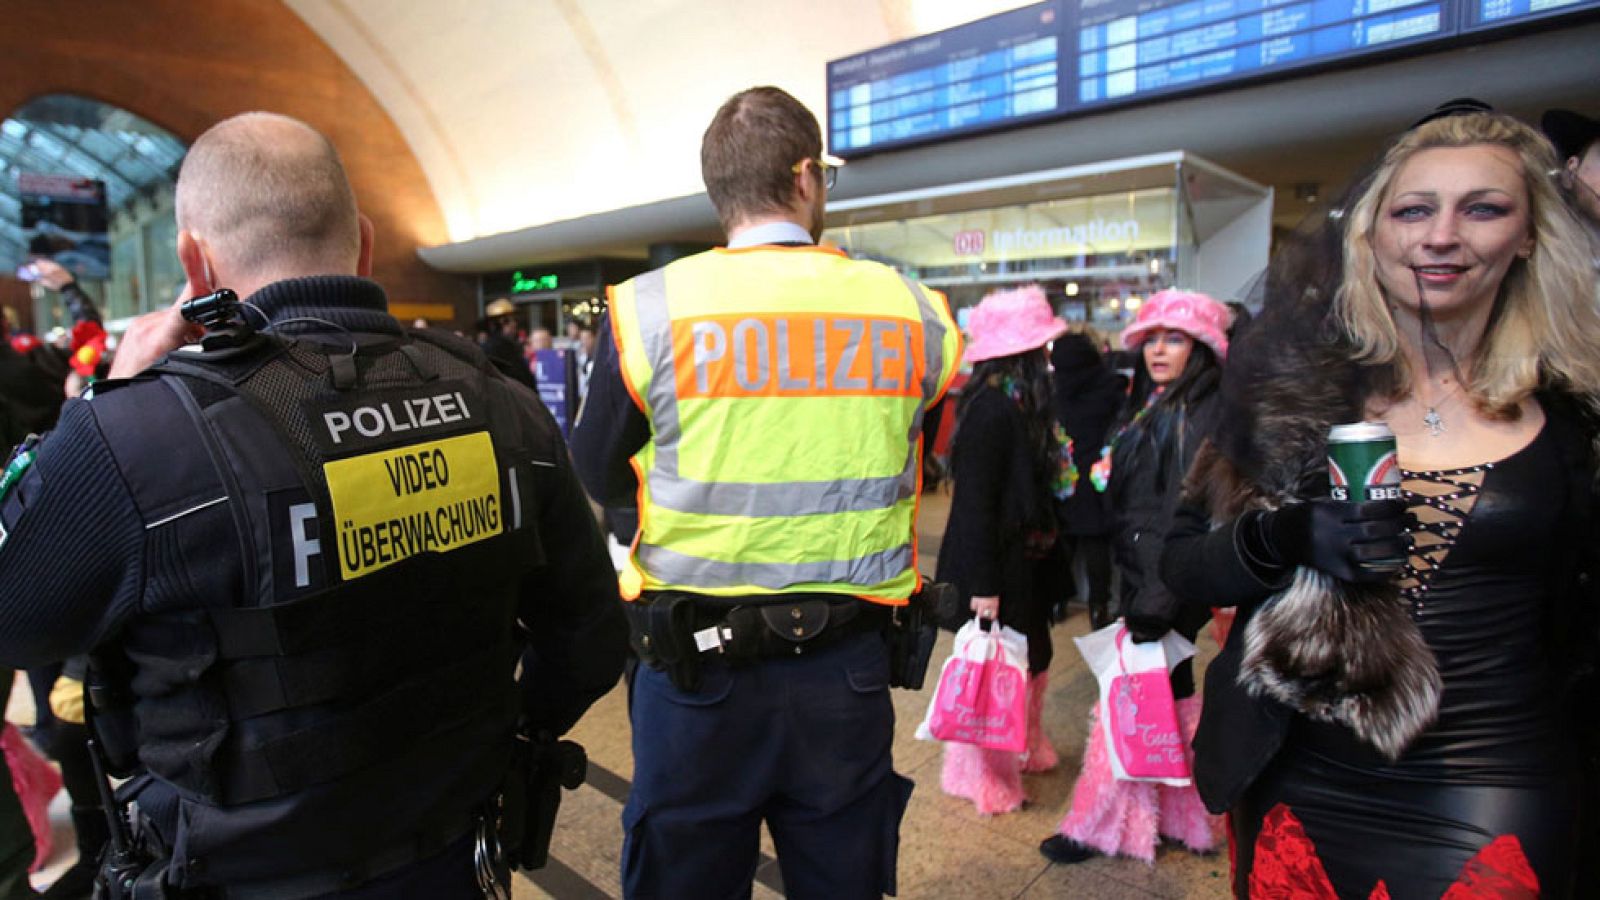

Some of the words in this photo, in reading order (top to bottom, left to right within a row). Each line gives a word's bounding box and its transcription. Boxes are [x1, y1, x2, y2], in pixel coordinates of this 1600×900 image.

[993, 218, 1139, 251] Information
[692, 318, 913, 392] POLIZEI
[323, 391, 471, 443] POLIZEI
[384, 448, 450, 497] VIDEO
[342, 494, 498, 572] ÜBERWACHUNG
